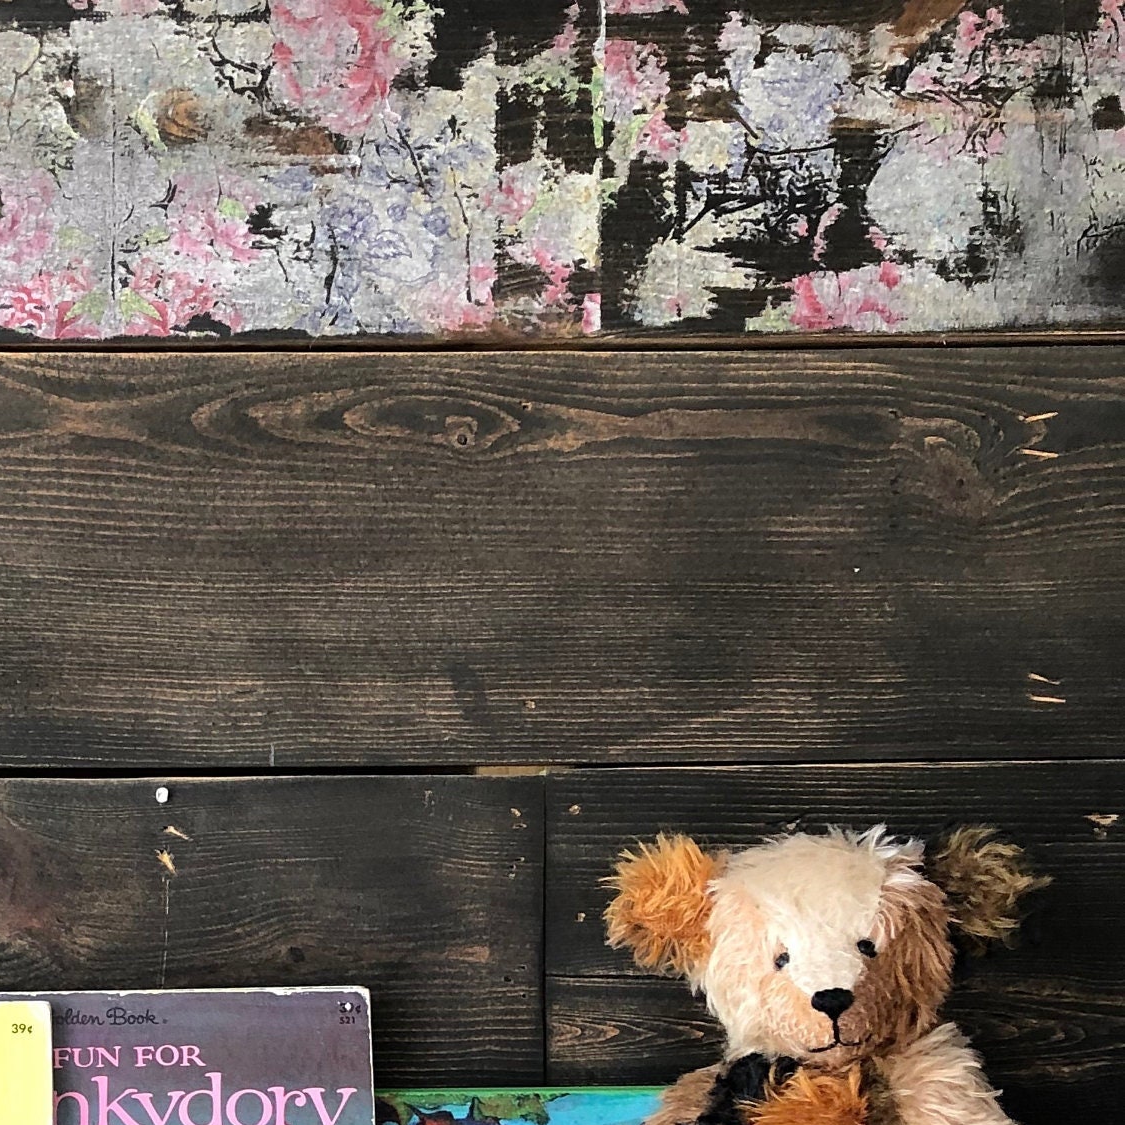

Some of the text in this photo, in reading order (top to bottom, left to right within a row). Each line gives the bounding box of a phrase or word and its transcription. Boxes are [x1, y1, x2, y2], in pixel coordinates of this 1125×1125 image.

[106, 1006, 159, 1026] Book
[11, 1023, 33, 1034] 39¢
[53, 1044, 207, 1069] FUN FOR
